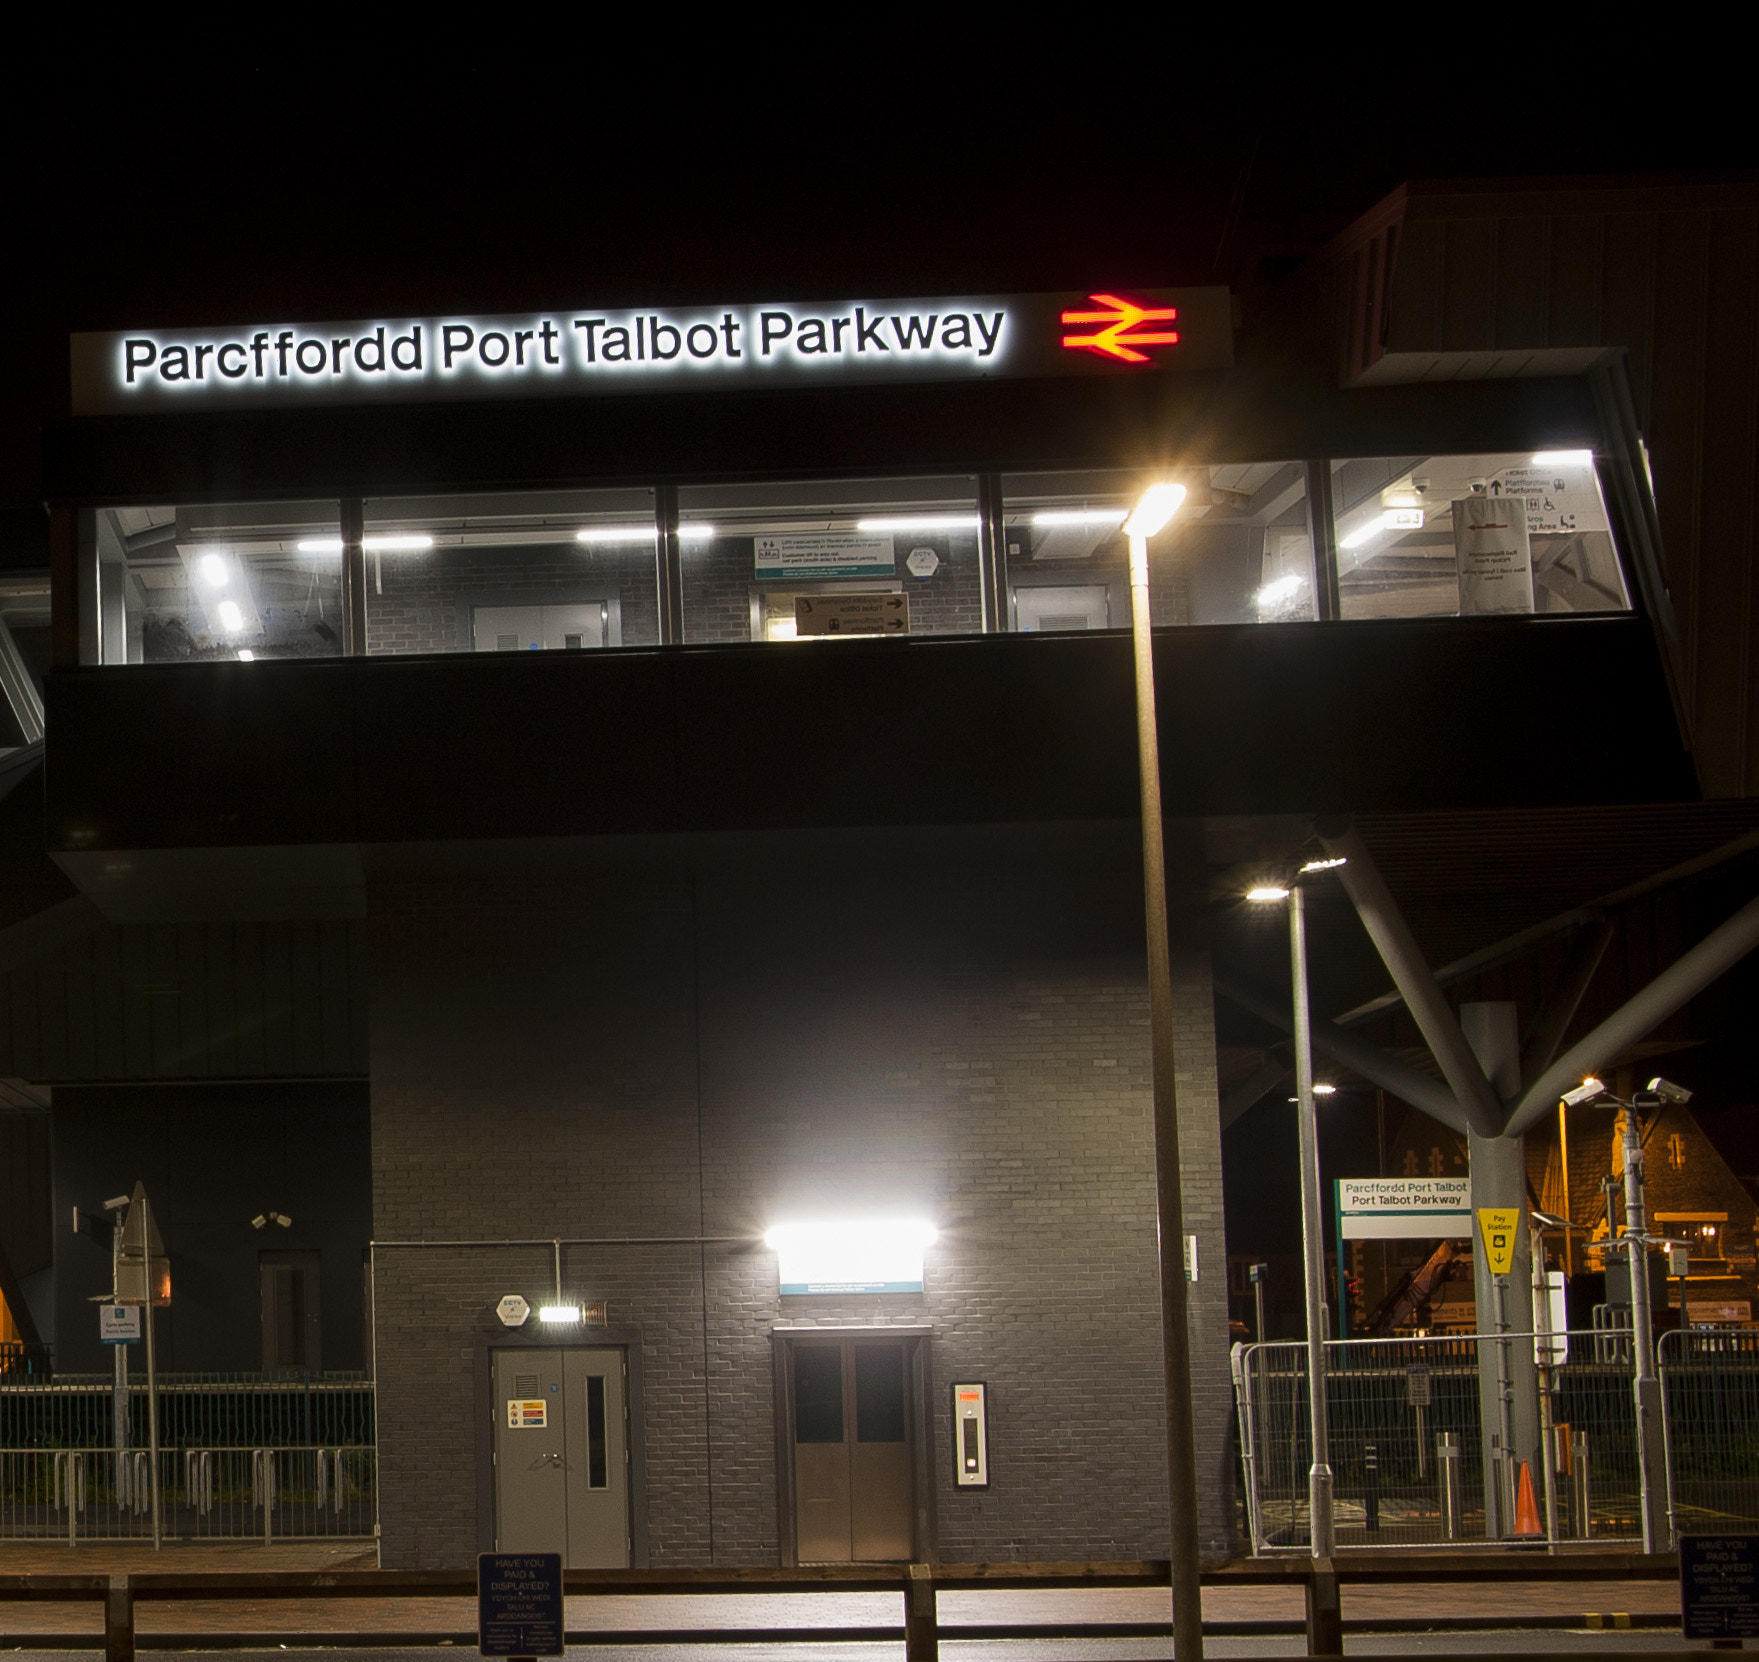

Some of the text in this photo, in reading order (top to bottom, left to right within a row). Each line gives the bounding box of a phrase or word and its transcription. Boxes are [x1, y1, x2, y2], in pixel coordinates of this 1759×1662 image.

[125, 307, 1005, 383] Parcffordd Port Talbot Parkway
[1505, 487, 1543, 495] Platforms
[1345, 1181, 1467, 1193] Parcffordd Port Talbot
[1352, 1194, 1462, 1207] Port Talbot Parkway
[1493, 1215, 1506, 1223] Pay
[1486, 1222, 1513, 1231] Station
[1724, 1540, 1748, 1550] YOU
[495, 1558, 545, 1568] HAVE YOU
[503, 1570, 527, 1579] PAID
[490, 1581, 550, 1591] DISPLAYED?
